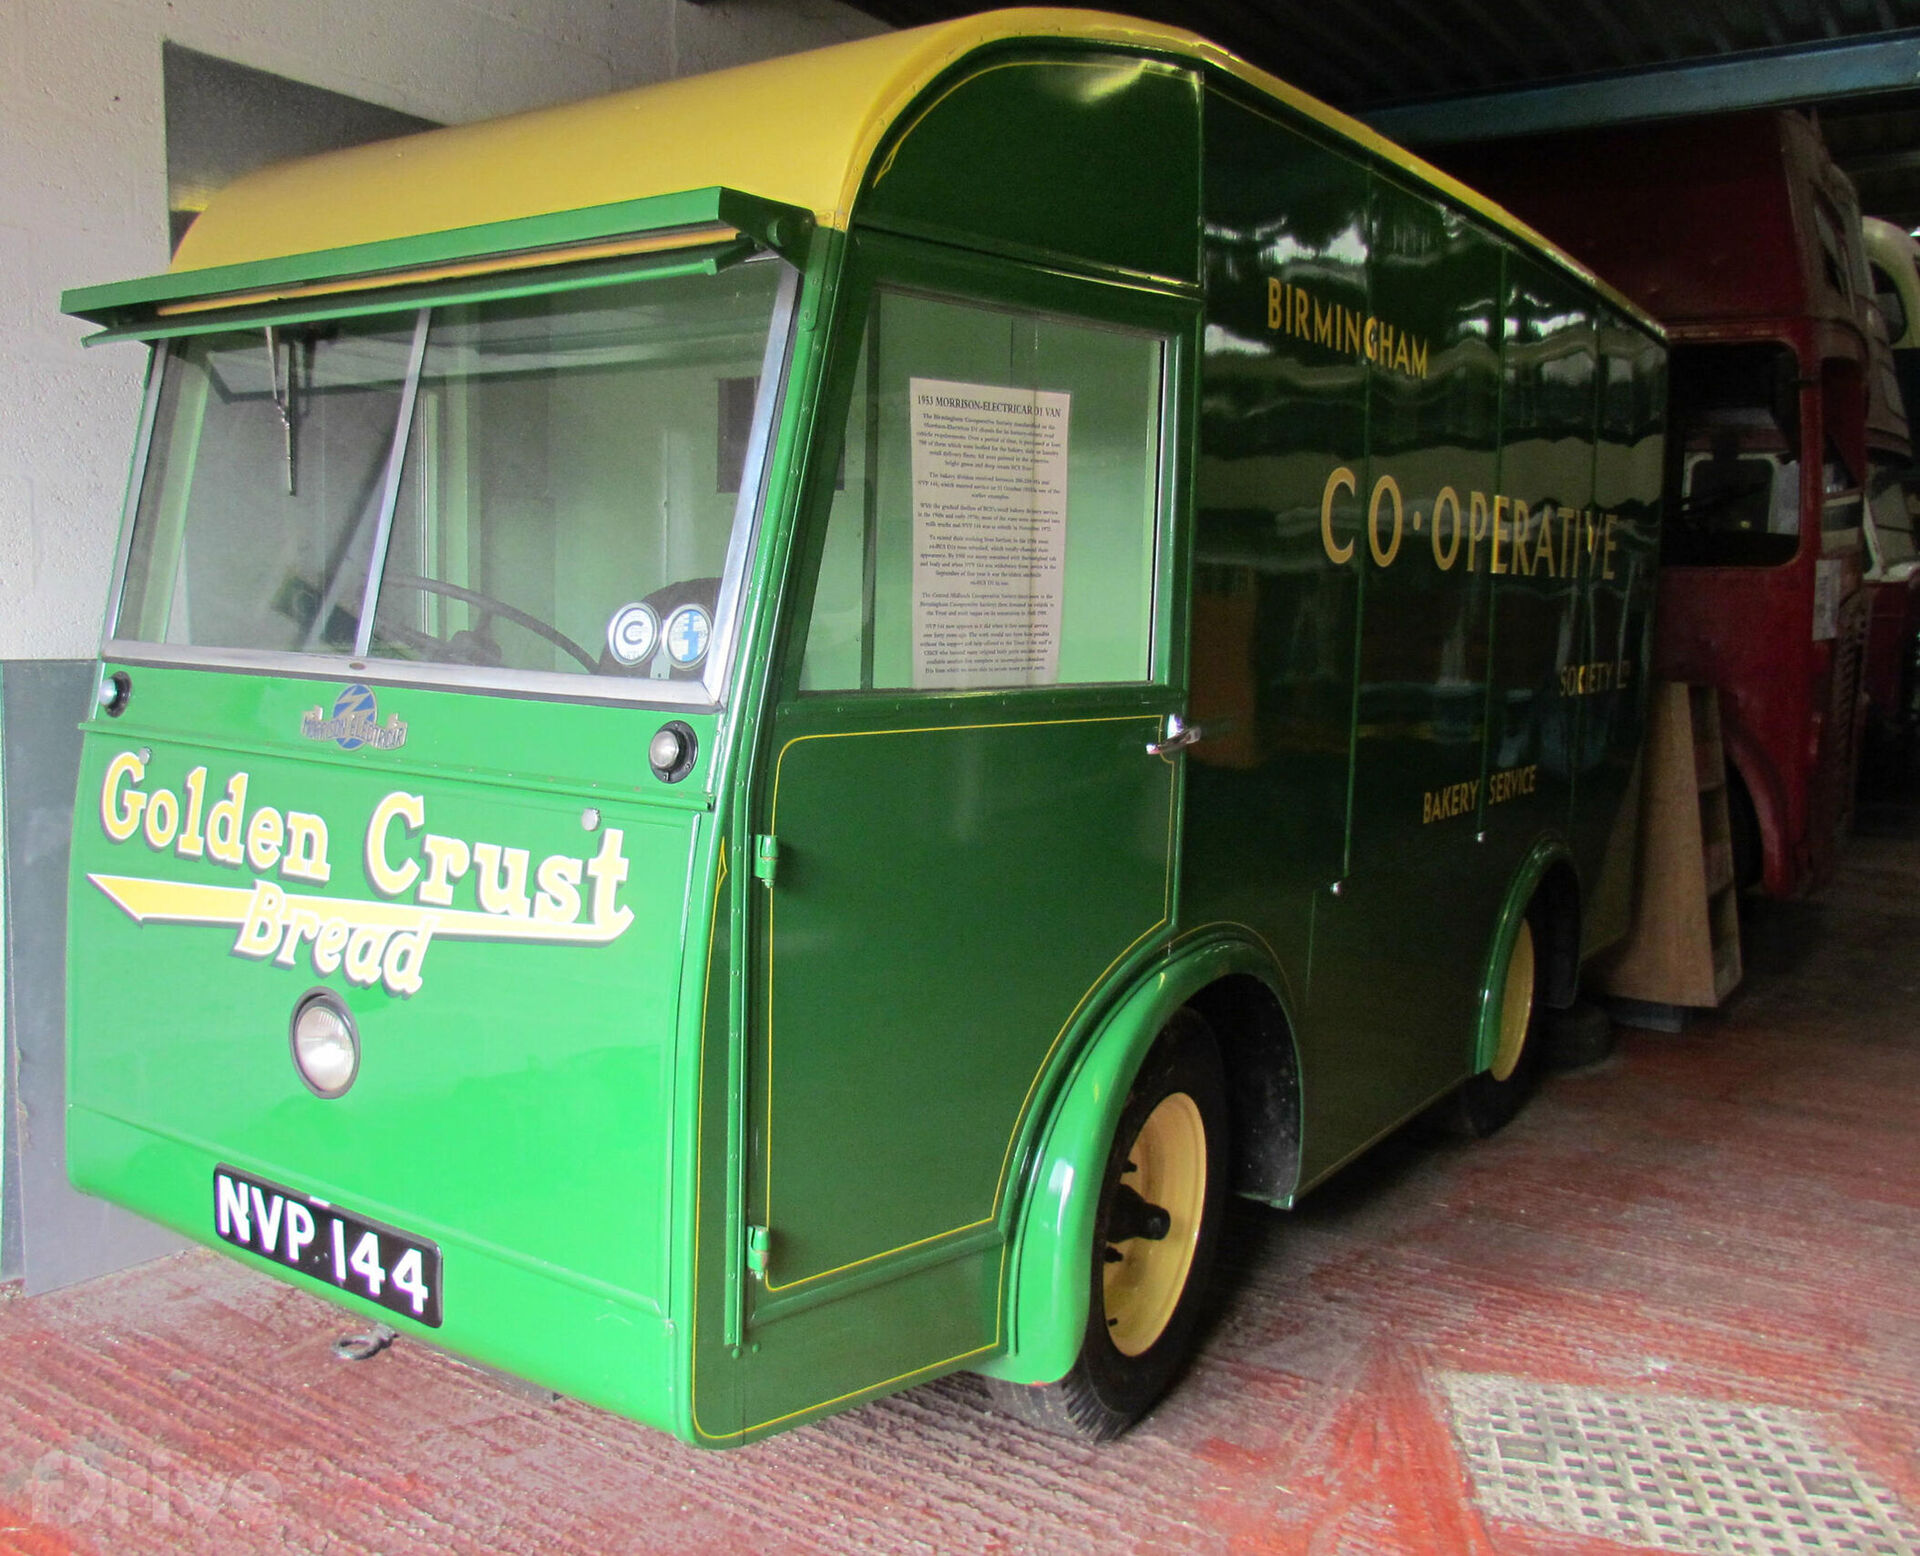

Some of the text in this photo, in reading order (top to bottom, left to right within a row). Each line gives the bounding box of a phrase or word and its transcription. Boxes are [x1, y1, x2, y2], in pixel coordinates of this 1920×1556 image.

[1268, 277, 1428, 379] BIRMINGHAM
[918, 395, 934, 406] 1953
[1045, 407, 1061, 418] VAN
[101, 750, 635, 942] Golden Crust
[1423, 764, 1537, 824] BAKERY SERVICE
[231, 879, 441, 996] Bread
[216, 1174, 429, 1315] NVP 144
